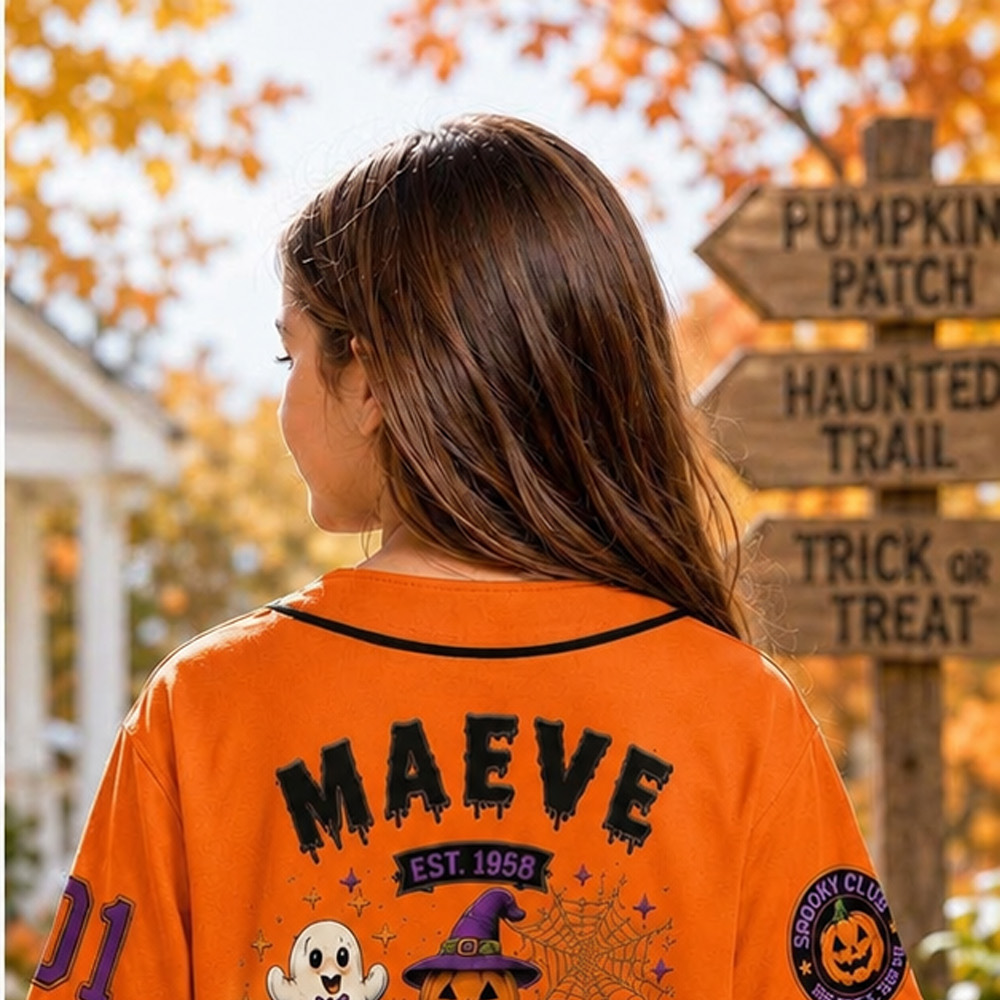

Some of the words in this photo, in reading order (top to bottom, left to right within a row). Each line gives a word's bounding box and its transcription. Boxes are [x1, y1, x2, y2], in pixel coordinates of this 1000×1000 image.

[781, 198, 1000, 251] PUMPKIN
[829, 256, 975, 308] PATCH
[782, 357, 1000, 415] HAUNTED
[820, 424, 956, 475] TRAIL
[796, 528, 933, 586] TRICK
[946, 549, 990, 586] OR
[832, 595, 977, 645] TREAT
[275, 712, 673, 864] MAEVE
[410, 850, 465, 882] EST.
[473, 850, 536, 880] 1958
[793, 874, 839, 949] SPOOKY
